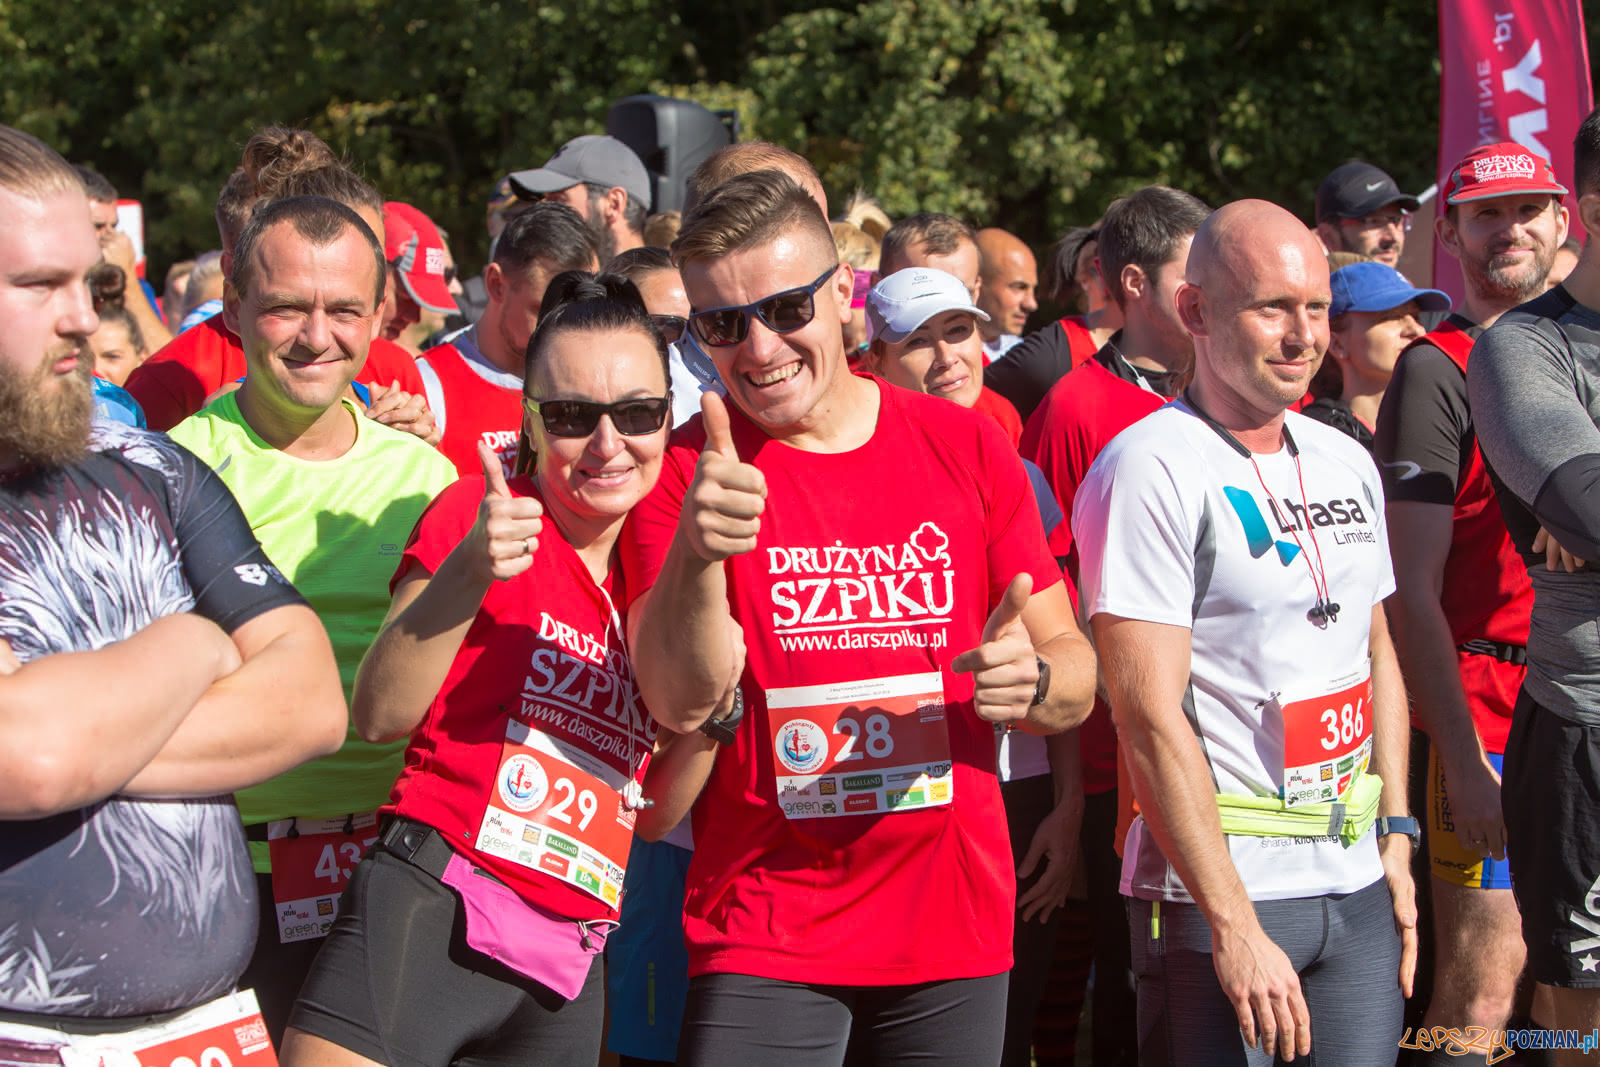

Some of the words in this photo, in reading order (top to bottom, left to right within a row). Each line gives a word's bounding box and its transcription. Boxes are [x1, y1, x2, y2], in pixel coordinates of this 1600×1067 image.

[1474, 159, 1536, 178] SZPIKU
[1267, 498, 1368, 534] Lhasa
[1333, 530, 1376, 545] Limited
[766, 540, 923, 574] DRUŻYNA
[771, 570, 955, 628] SZPIKU
[779, 628, 948, 652] www.darszpiku.pl
[832, 714, 894, 762] 28
[1320, 697, 1364, 751] 386
[546, 777, 598, 832] 29
[784, 799, 821, 816] green
[284, 922, 319, 939] green
